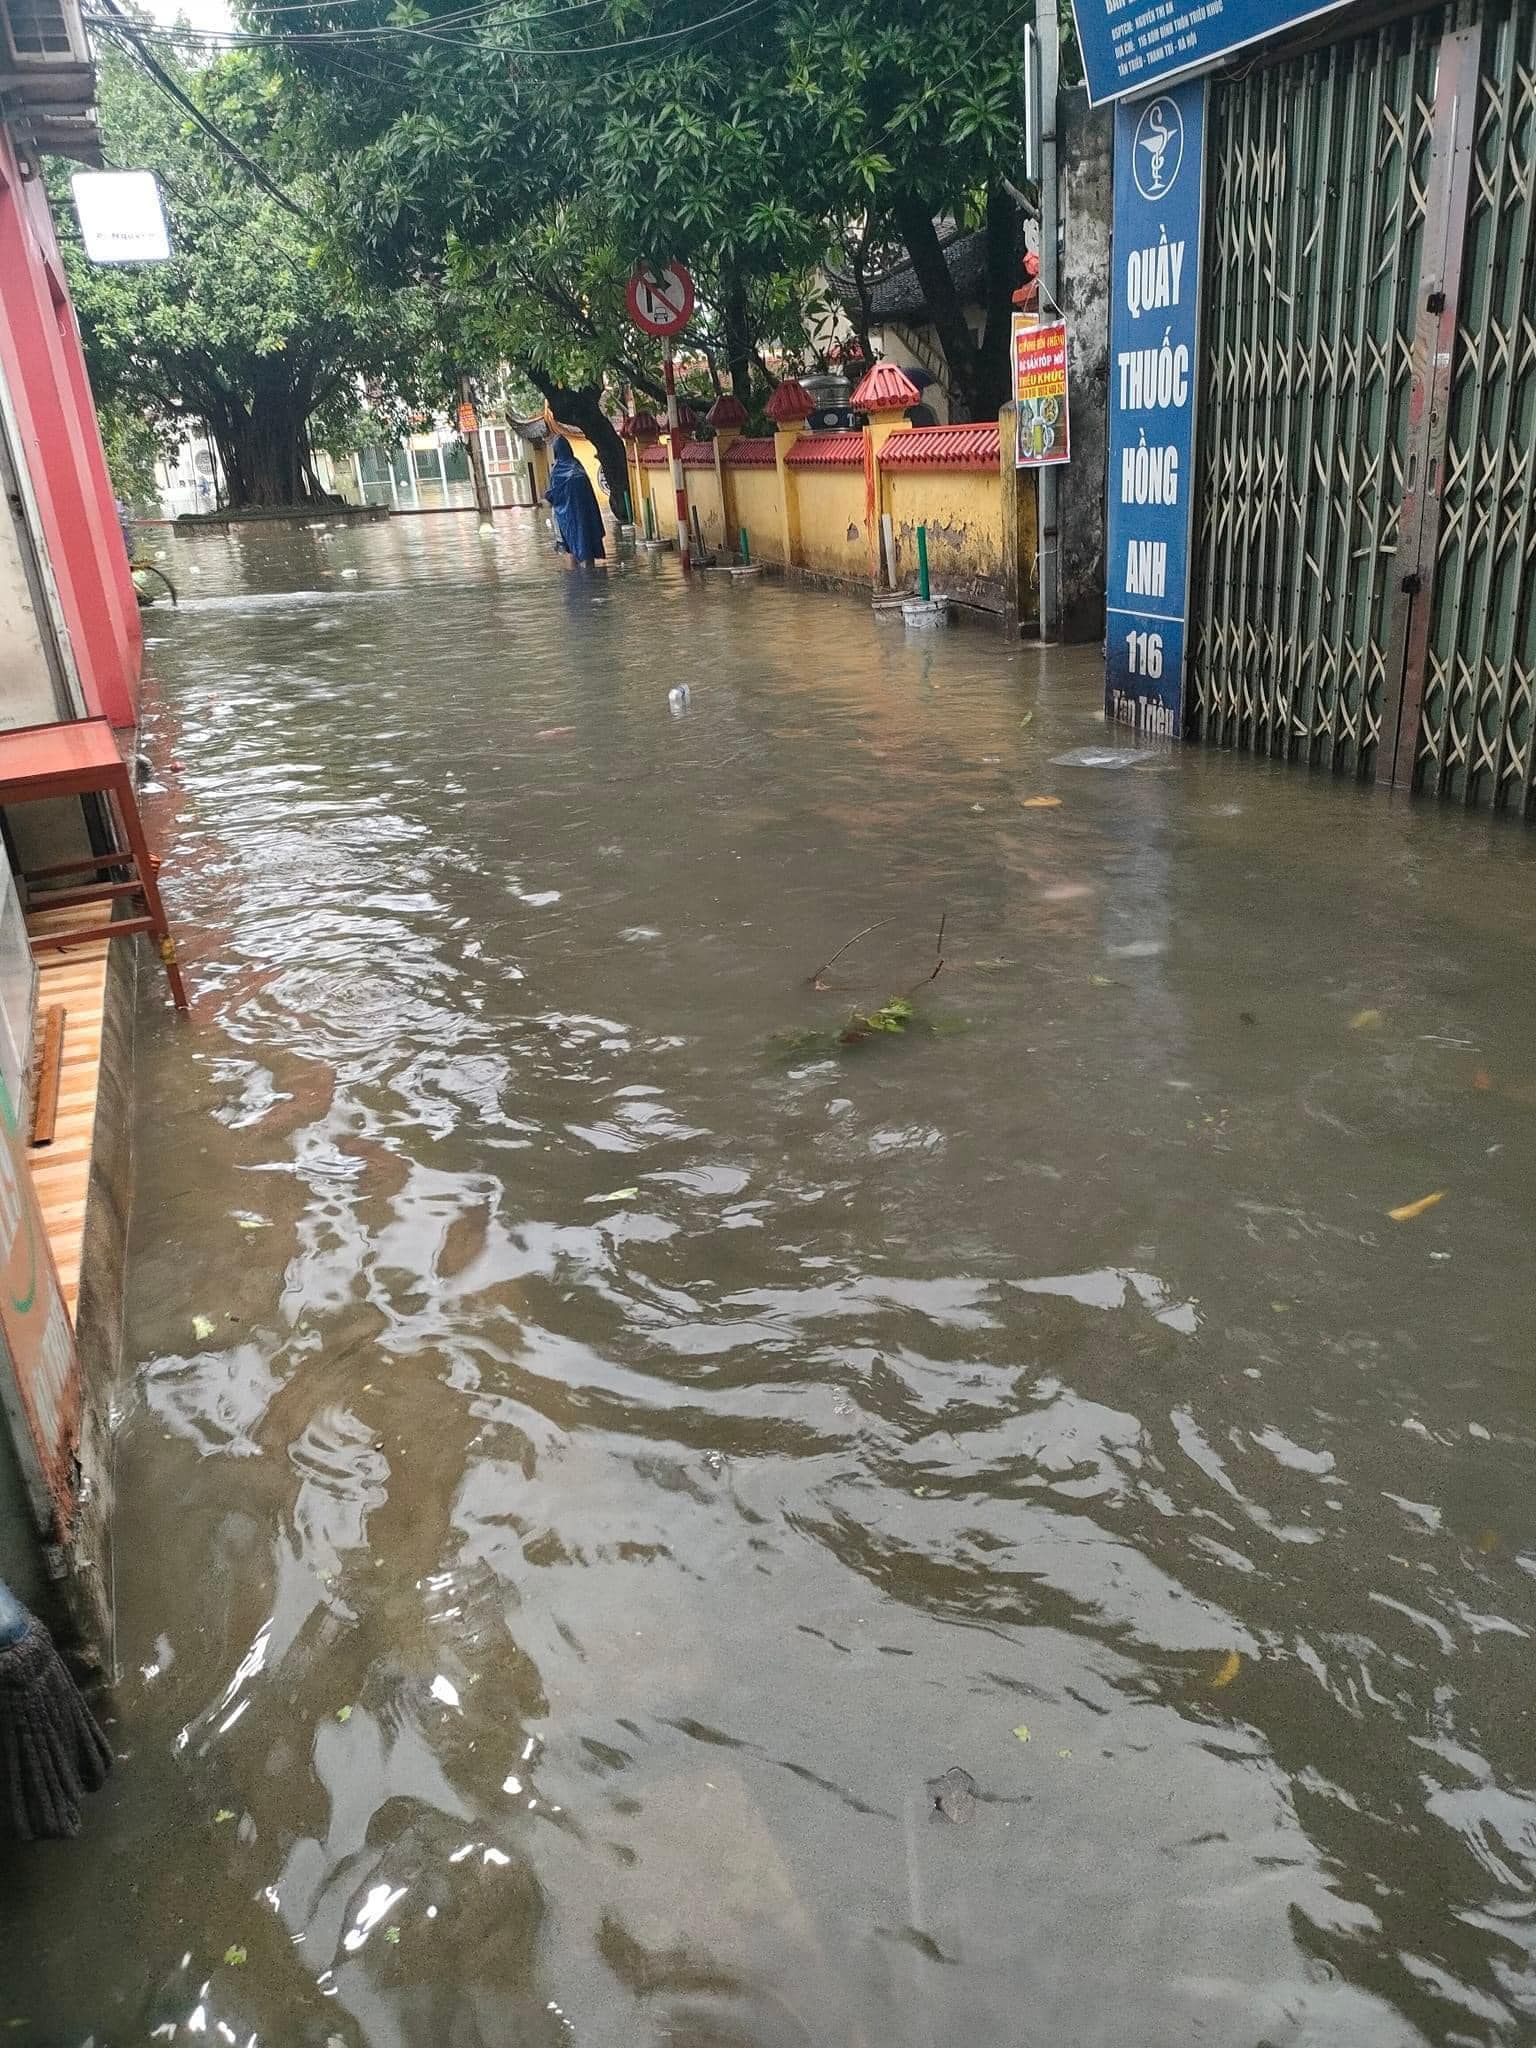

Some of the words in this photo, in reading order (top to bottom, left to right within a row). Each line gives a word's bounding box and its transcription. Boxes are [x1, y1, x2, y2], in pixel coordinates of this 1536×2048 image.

[1127, 224, 1185, 319] QUẦY
[1118, 325, 1189, 410] THUỐC
[1122, 427, 1179, 505] HỒNG
[1126, 540, 1167, 598] ANH
[1126, 630, 1163, 679] 116
